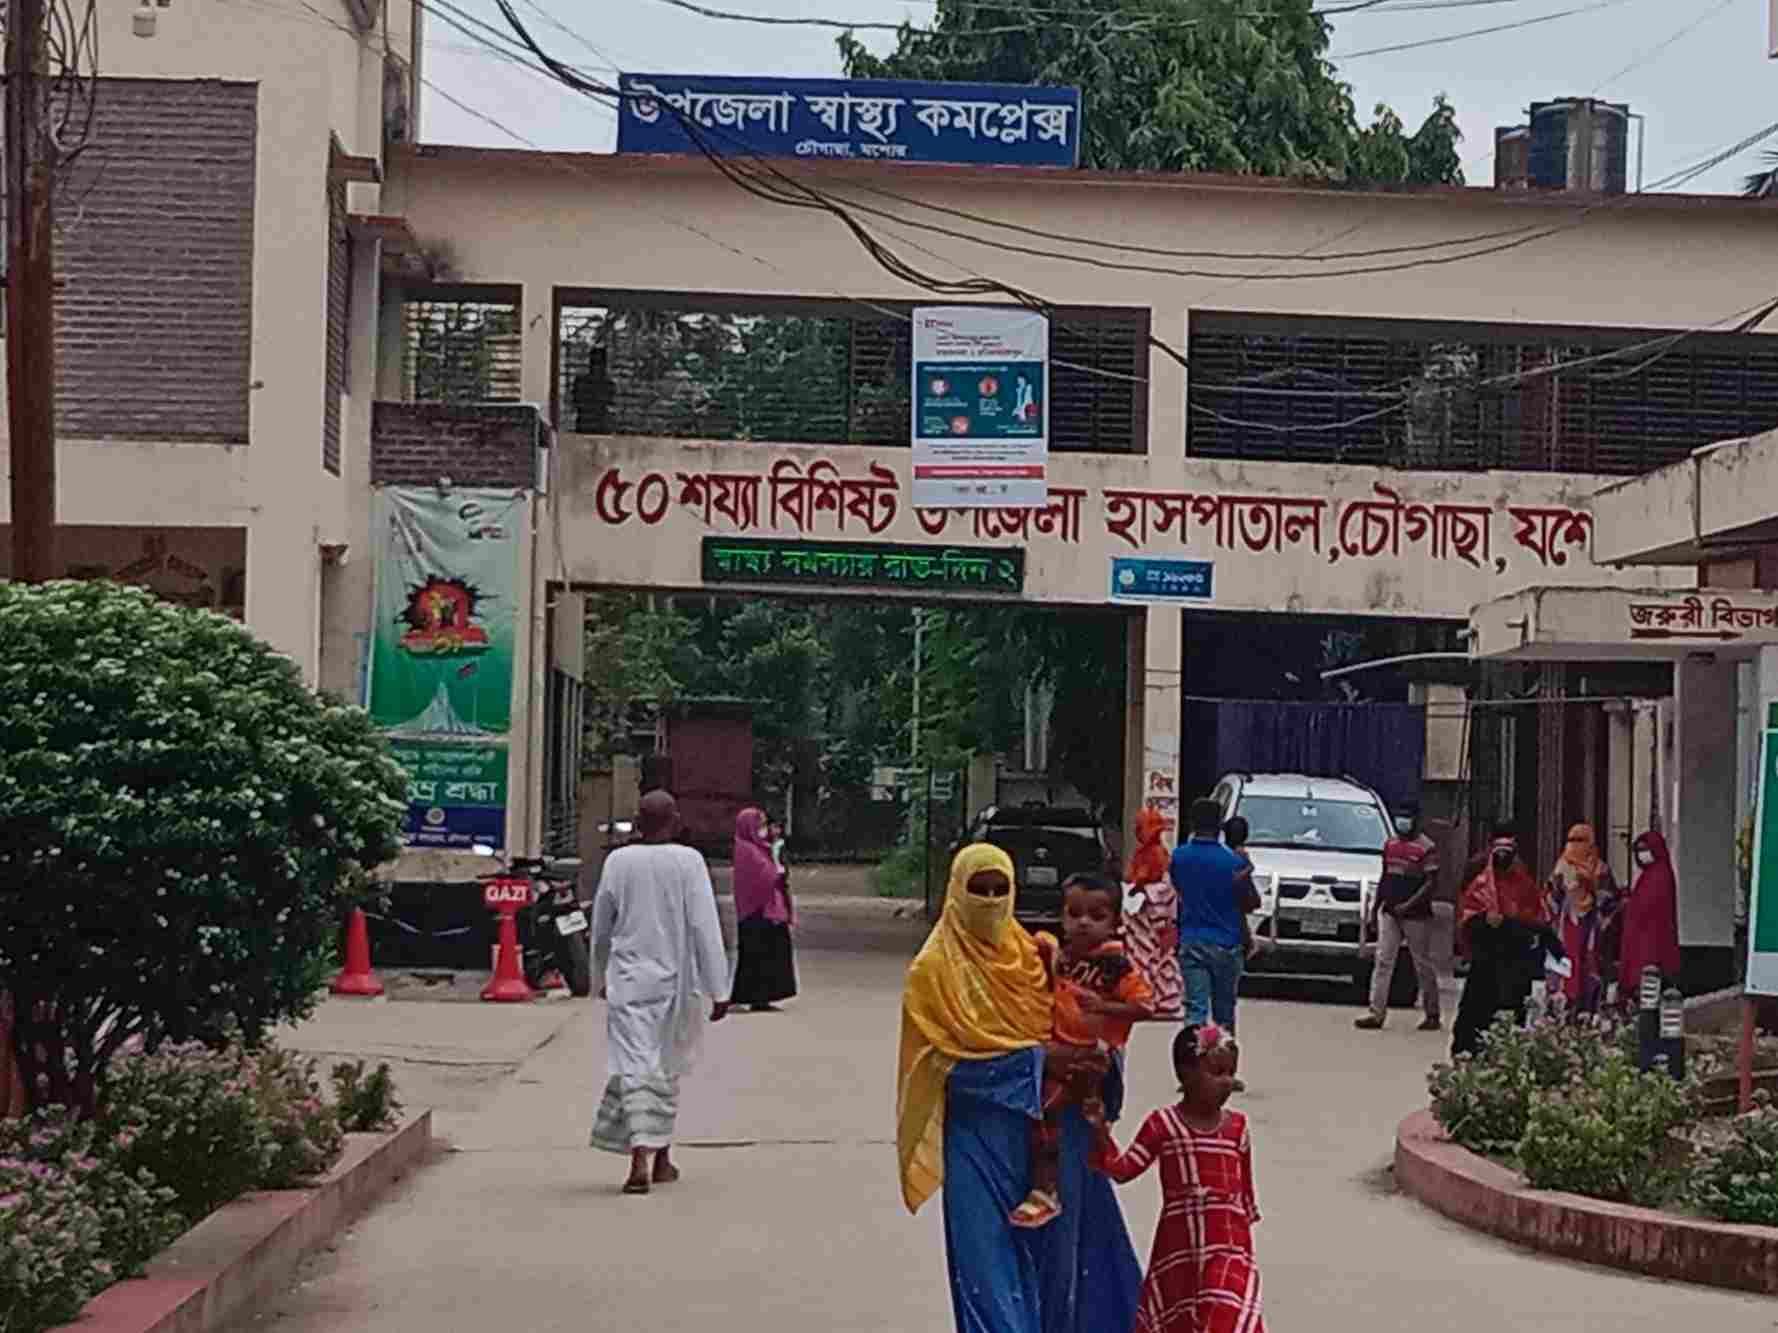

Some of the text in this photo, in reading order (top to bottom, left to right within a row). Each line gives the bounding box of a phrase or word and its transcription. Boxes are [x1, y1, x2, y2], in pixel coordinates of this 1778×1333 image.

[630, 81, 1074, 145] উপজেলা স্বাস্থ্য কমপ্লেক্স
[595, 466, 670, 525] ৫০
[678, 474, 762, 531] শয্যা
[768, 459, 900, 535] বিশিষ্ট
